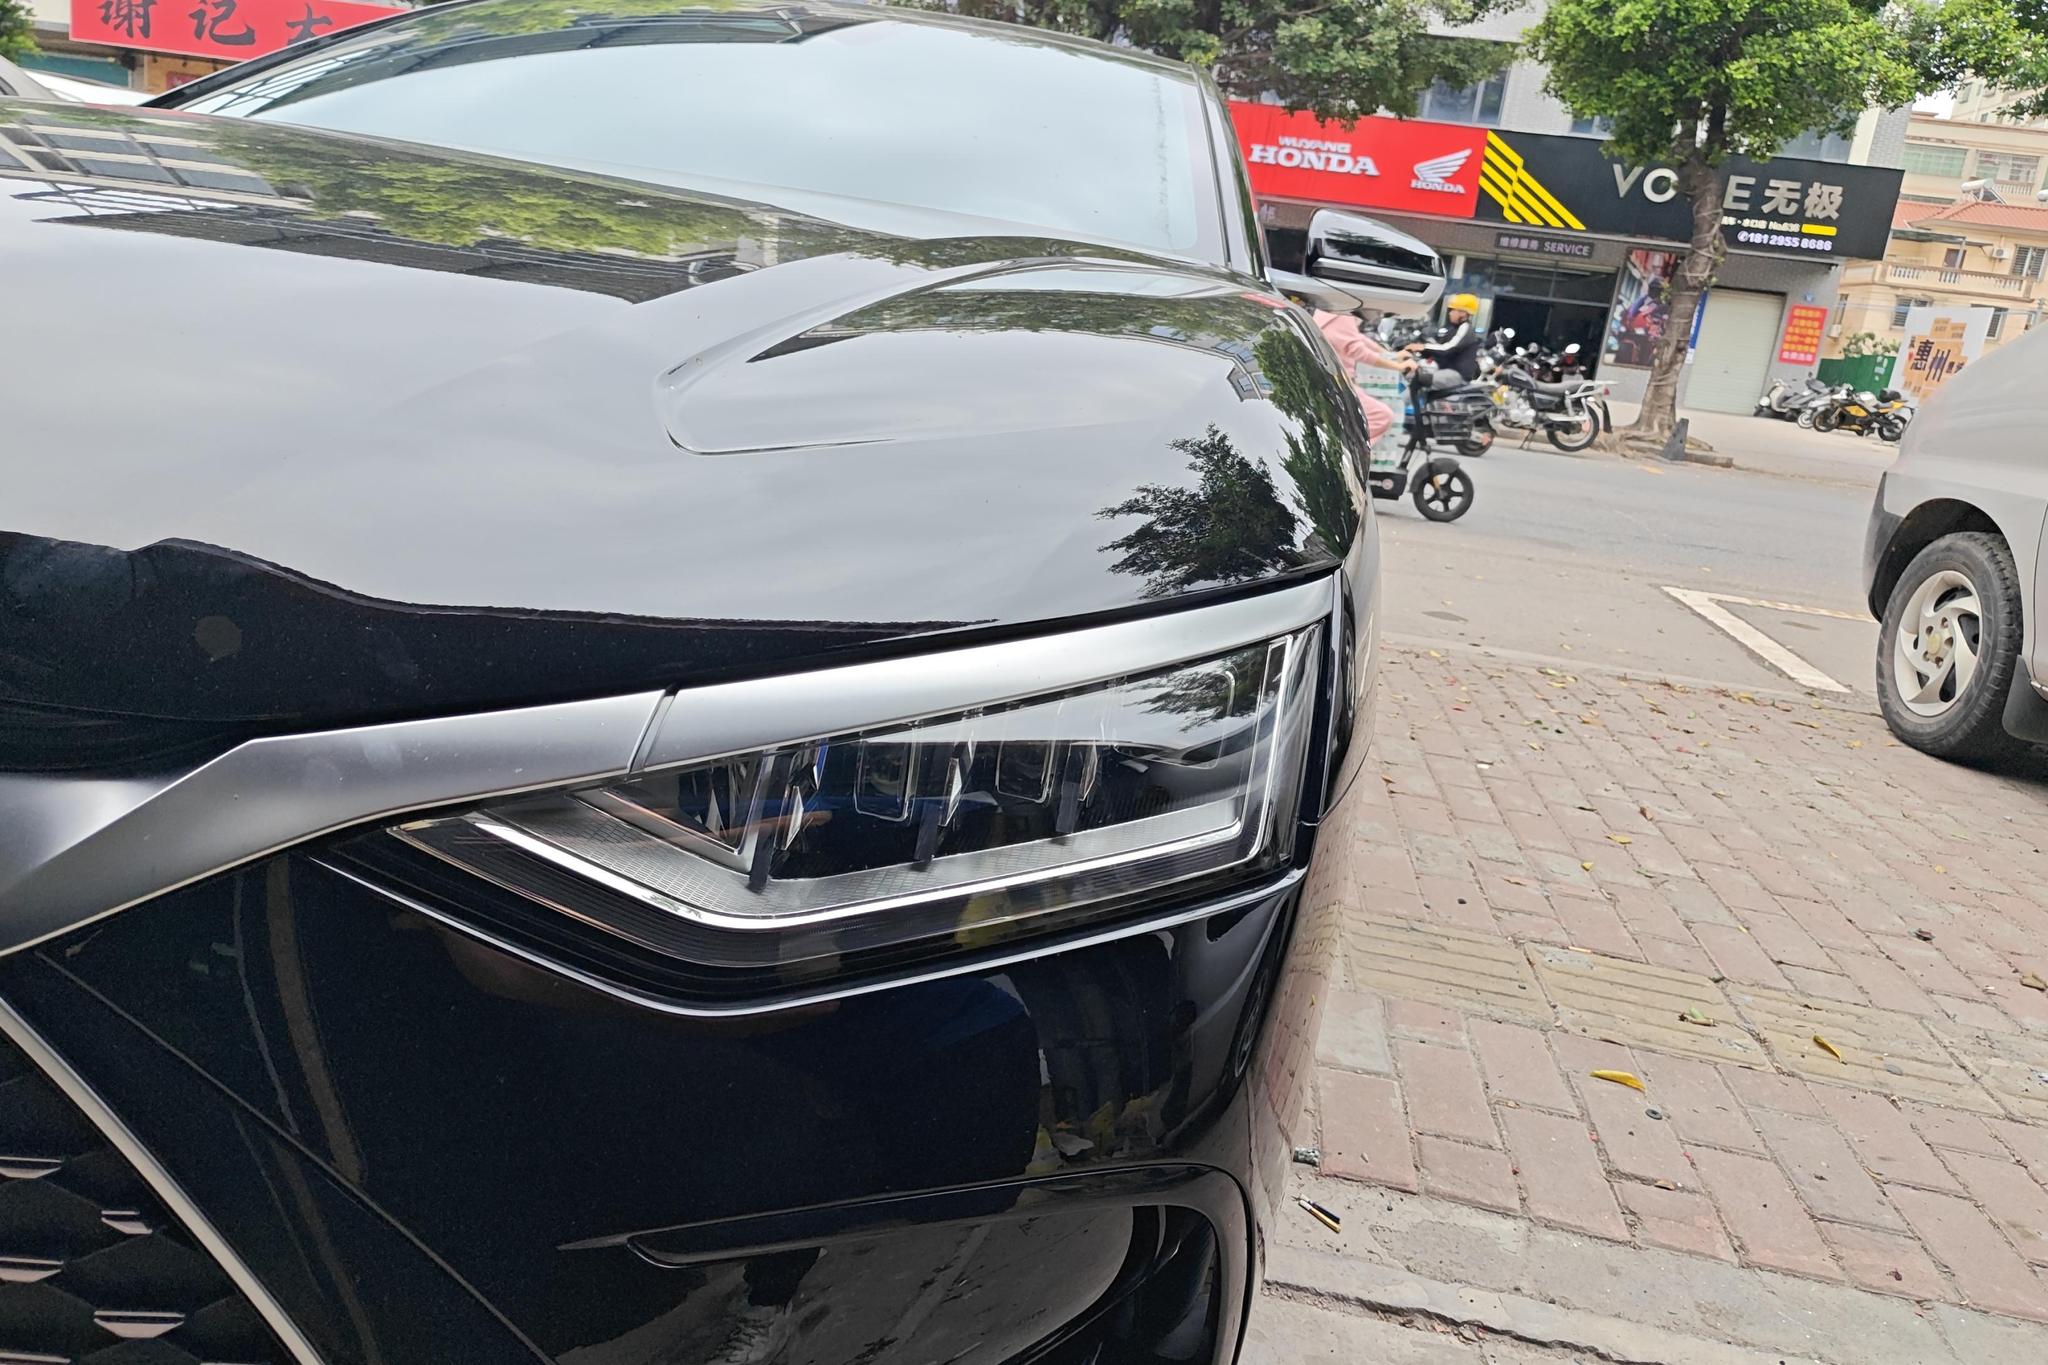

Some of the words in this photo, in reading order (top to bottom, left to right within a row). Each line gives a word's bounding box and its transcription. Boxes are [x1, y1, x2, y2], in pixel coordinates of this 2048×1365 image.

[1248, 144, 1380, 177] HONDA
[1410, 179, 1466, 194] HONDA
[1613, 164, 1756, 211] VOE
[1761, 178, 1844, 220] 无极
[1543, 240, 1591, 256] SERVICE
[1910, 339, 1951, 382] 惠州
